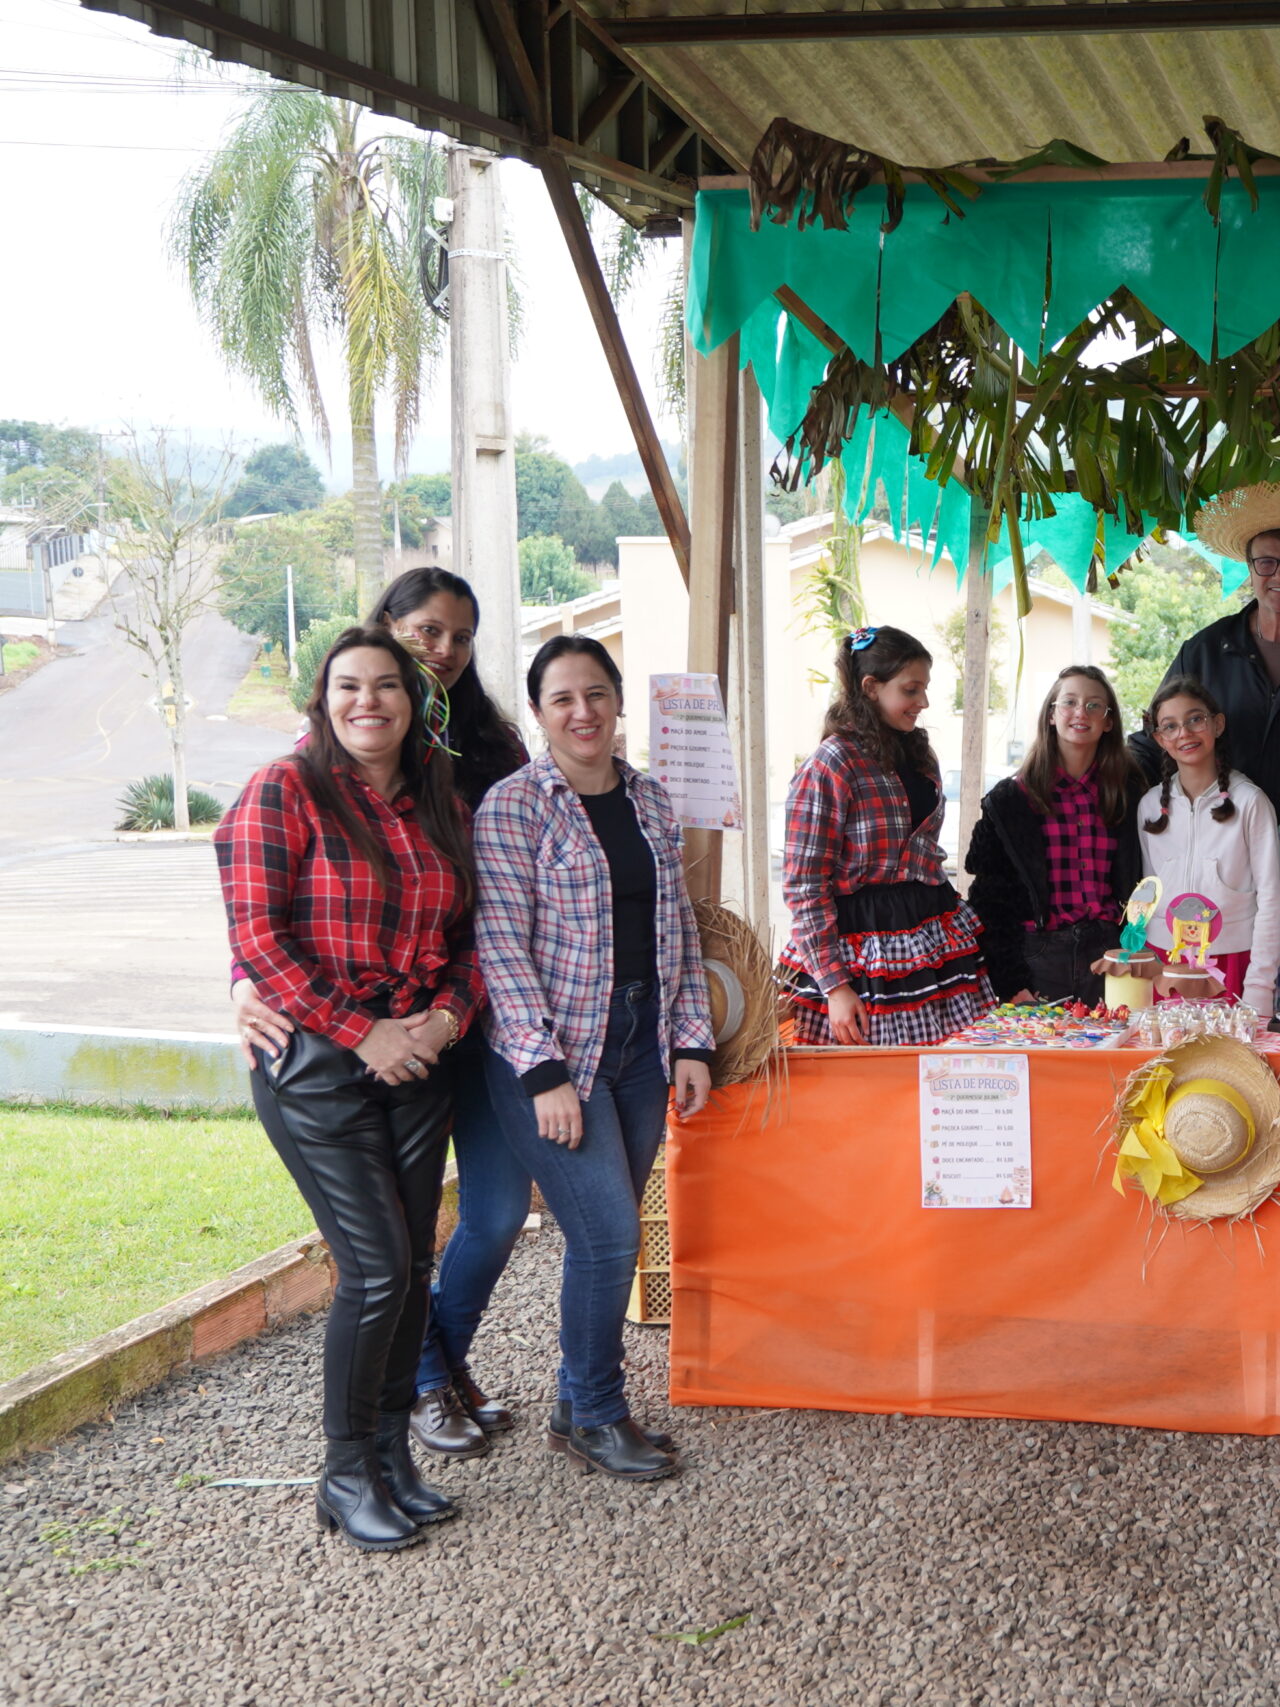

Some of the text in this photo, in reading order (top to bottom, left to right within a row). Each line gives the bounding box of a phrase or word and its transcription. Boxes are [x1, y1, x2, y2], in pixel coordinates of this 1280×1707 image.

[662, 698, 691, 710] LISTA
[693, 698, 705, 709] DE
[670, 727, 683, 735] MAÇÃ
[932, 1078, 1017, 1091] LISTA DE PREÇOS
